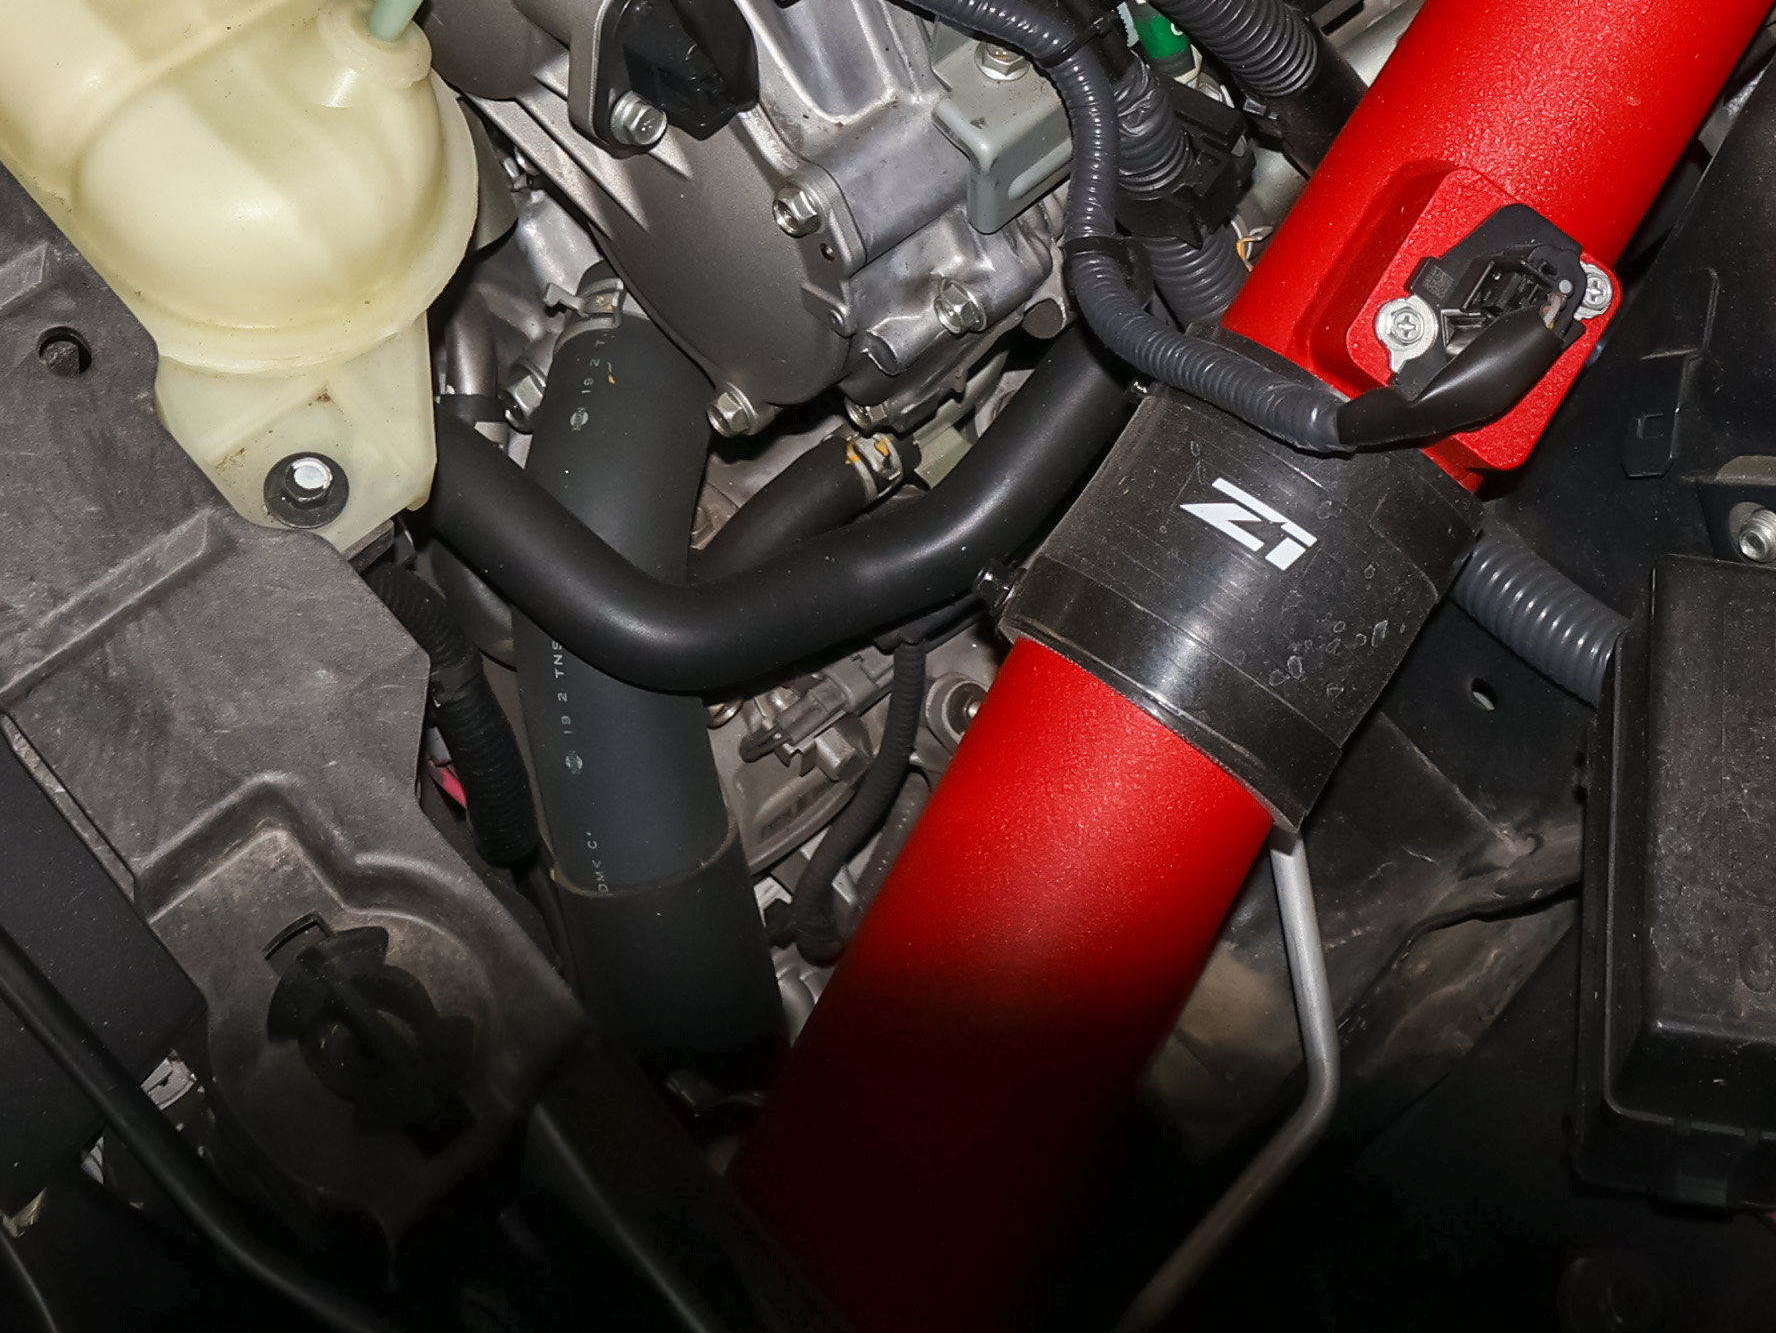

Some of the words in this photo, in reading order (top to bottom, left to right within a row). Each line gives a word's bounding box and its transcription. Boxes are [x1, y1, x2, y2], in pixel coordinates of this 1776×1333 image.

[588, 356, 601, 367] 2
[1180, 477, 1318, 571] Z1
[556, 691, 568, 703] 2
[560, 714, 573, 734] 19
